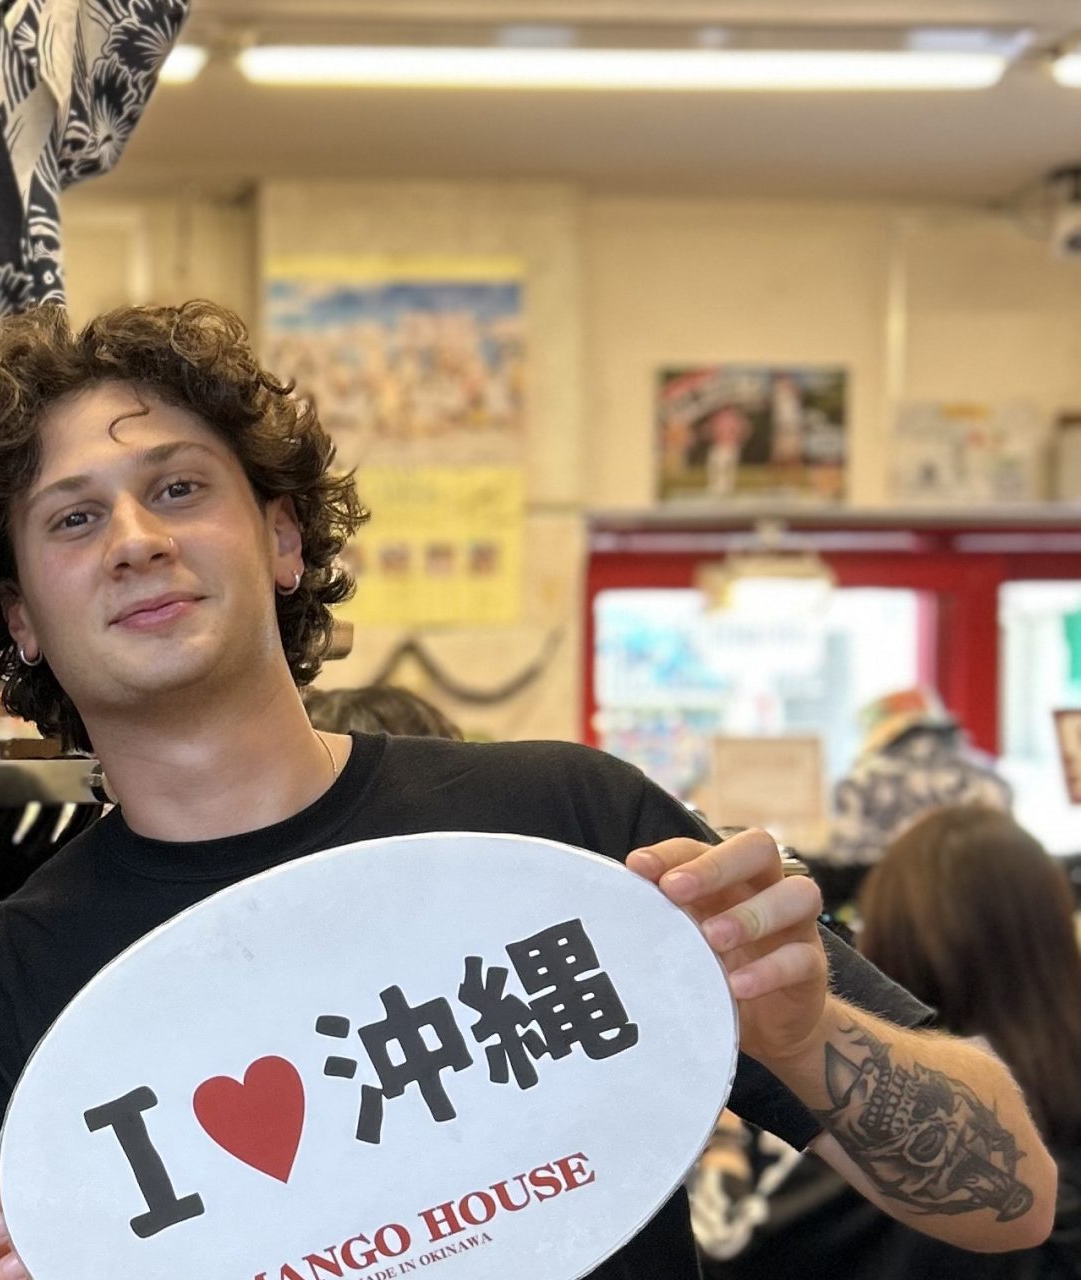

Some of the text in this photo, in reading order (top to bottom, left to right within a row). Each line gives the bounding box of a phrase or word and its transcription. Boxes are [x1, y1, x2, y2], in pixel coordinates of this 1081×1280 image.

[84, 917, 638, 1239] I 沖縄
[418, 1152, 595, 1242] HOUSE
[399, 1258, 417, 1274] IN
[419, 1231, 493, 1266] OKINAWA
